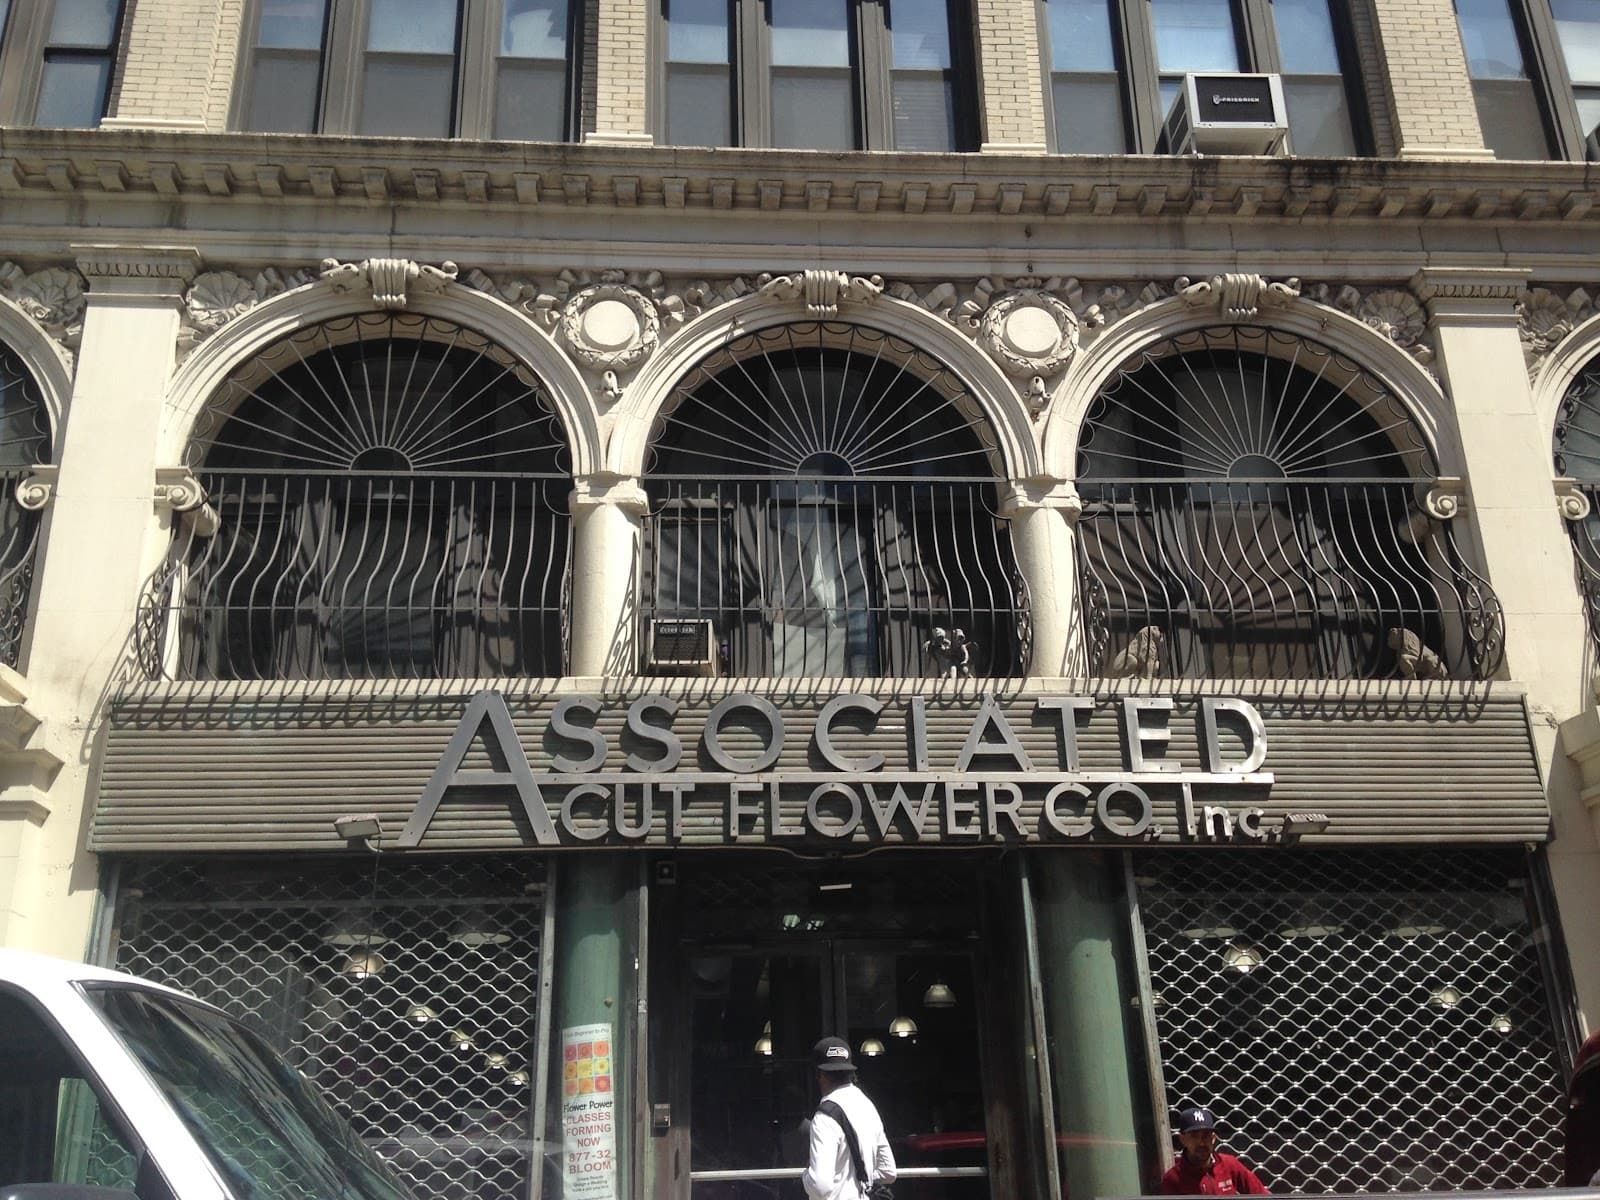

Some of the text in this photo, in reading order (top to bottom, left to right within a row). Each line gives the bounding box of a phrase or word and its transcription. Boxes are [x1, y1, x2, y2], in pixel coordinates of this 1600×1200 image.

[398, 689, 1268, 847] ASSOCIATED
[560, 782, 695, 841] CUT
[730, 782, 1029, 838] FLOWER
[563, 1100, 613, 1113] Flower Power
[566, 1111, 611, 1125] CLASSES
[566, 1123, 612, 1137] FORMING
[577, 1137, 600, 1148] NOW
[569, 1150, 611, 1162] 877-32
[569, 1161, 611, 1174] BLOOM
